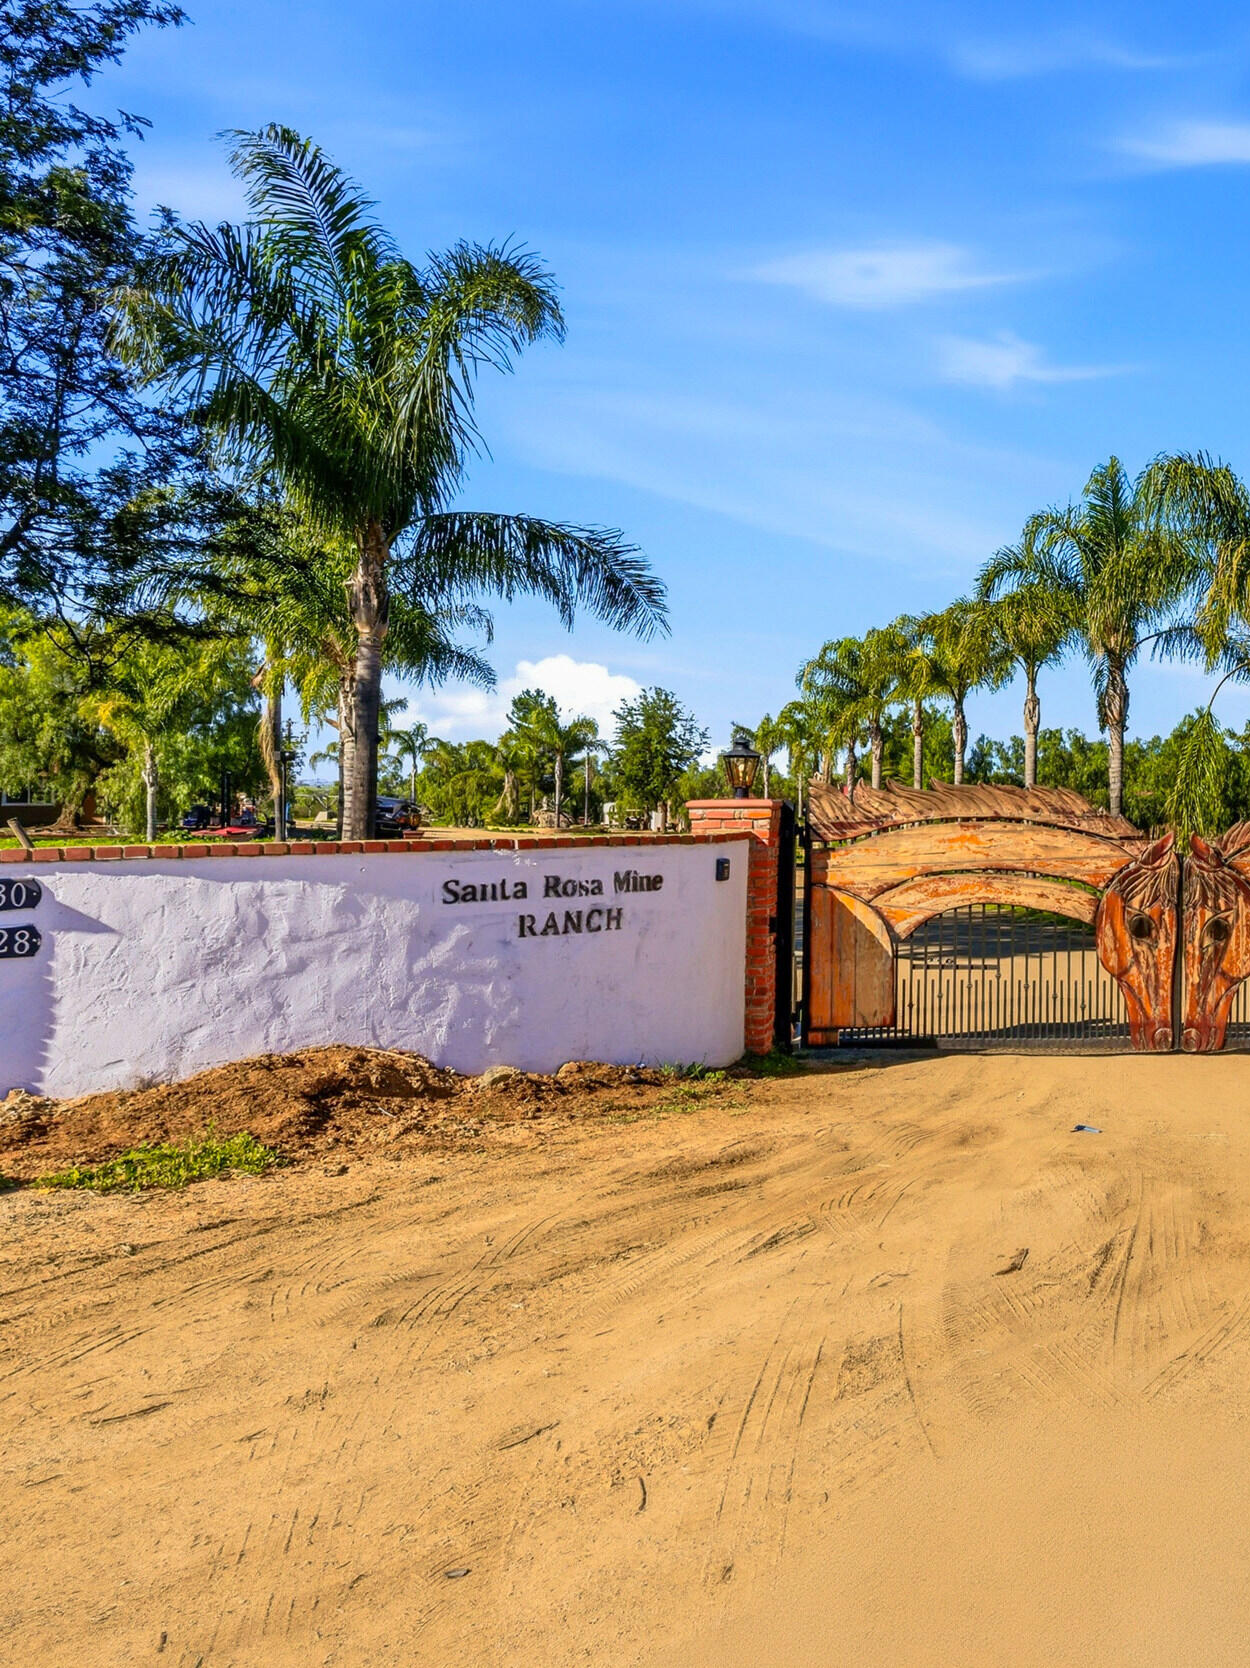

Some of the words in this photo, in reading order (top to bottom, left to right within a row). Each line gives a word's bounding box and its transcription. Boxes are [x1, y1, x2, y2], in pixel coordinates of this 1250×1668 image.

[442, 878, 528, 904] Santa
[543, 875, 604, 899] Rosa
[613, 870, 664, 894] Mine
[518, 907, 624, 938] RANCH
